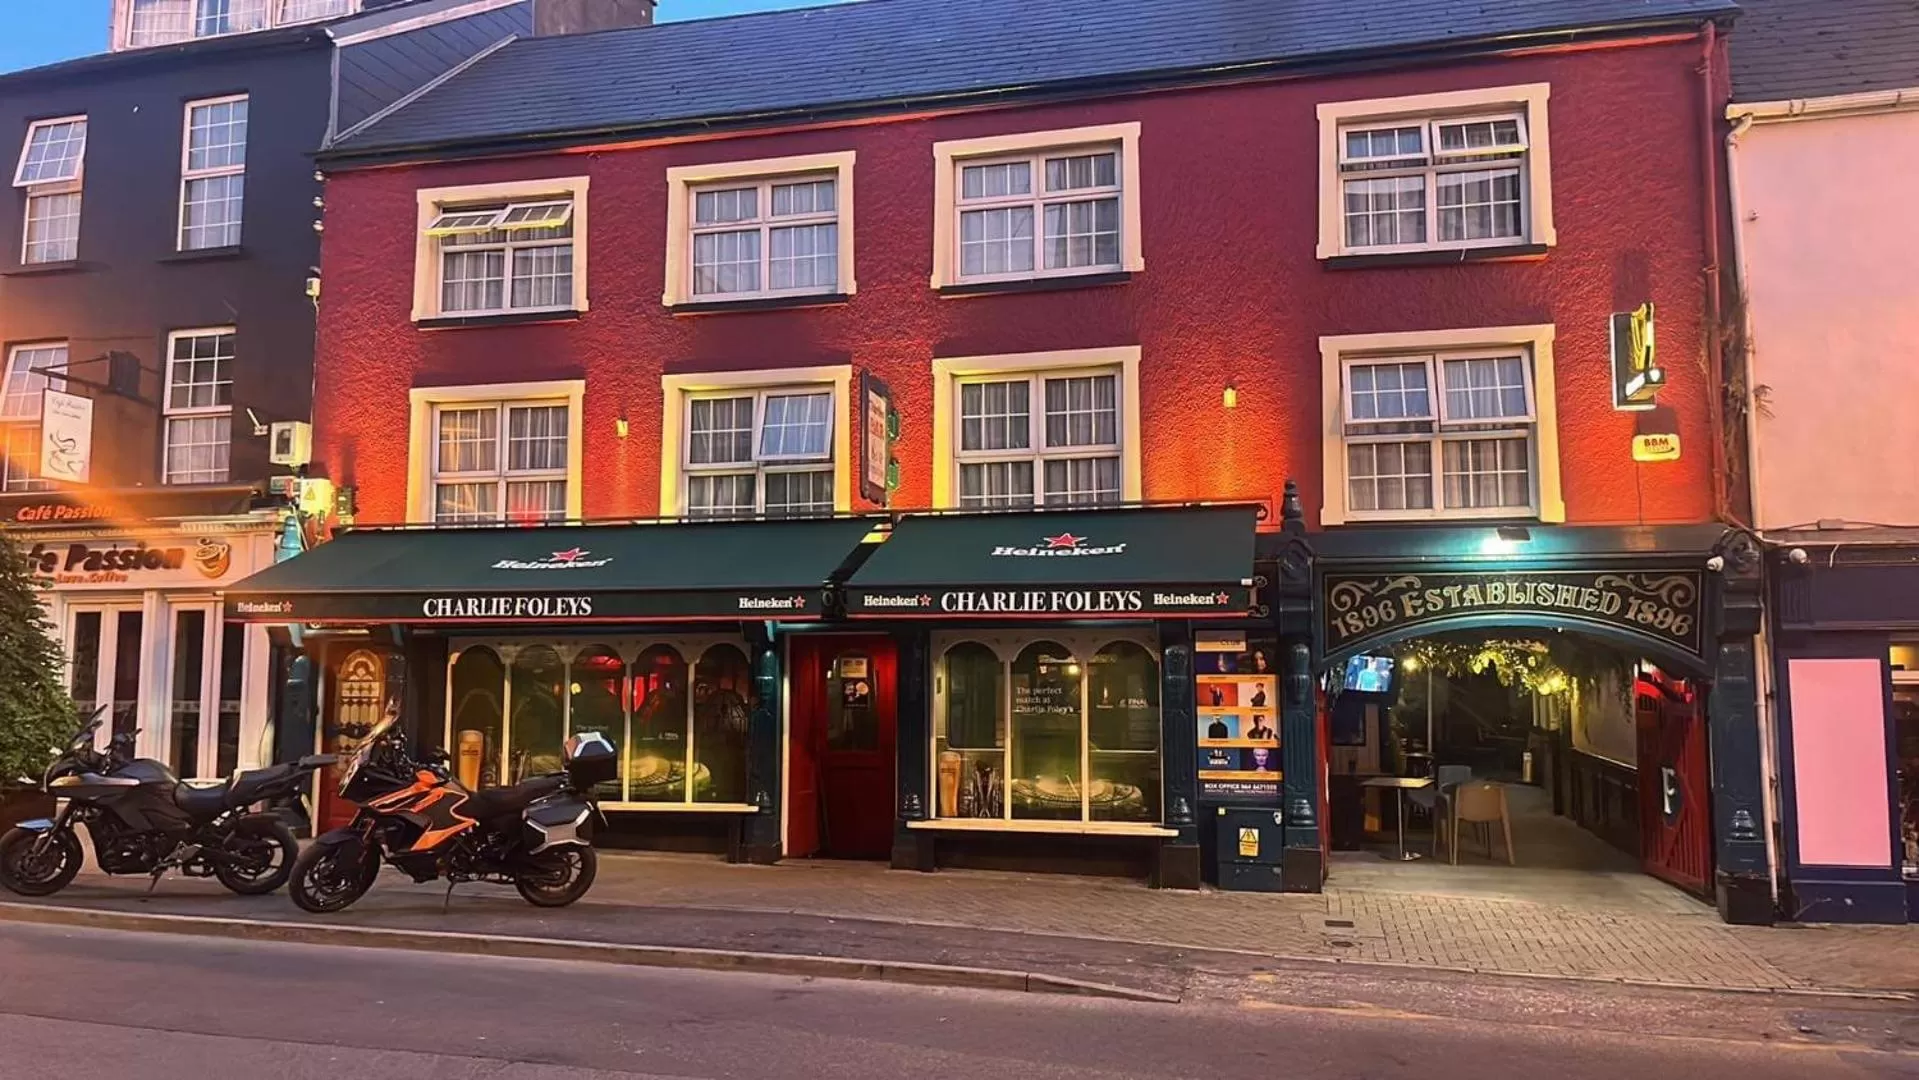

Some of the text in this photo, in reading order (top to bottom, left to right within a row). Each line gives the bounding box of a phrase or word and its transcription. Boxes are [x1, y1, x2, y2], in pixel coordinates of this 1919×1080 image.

[1643, 438, 1669, 447] BBM
[17, 503, 113, 521] Café Passion
[28, 541, 186, 573] fe Passion
[991, 543, 1127, 557] Heineken
[491, 557, 613, 570] Heineken
[738, 596, 793, 609] Heineken
[863, 595, 920, 608] Heineken
[941, 590, 1143, 613] CHARLIE FOLEYS
[1153, 592, 1216, 606] Heineken
[237, 602, 283, 613] Heineken
[422, 596, 593, 618] CHARLIE FOLEYS
[1331, 581, 1695, 639] 1896 ESTABLISHED 1896
[1032, 686, 1063, 696] perfect
